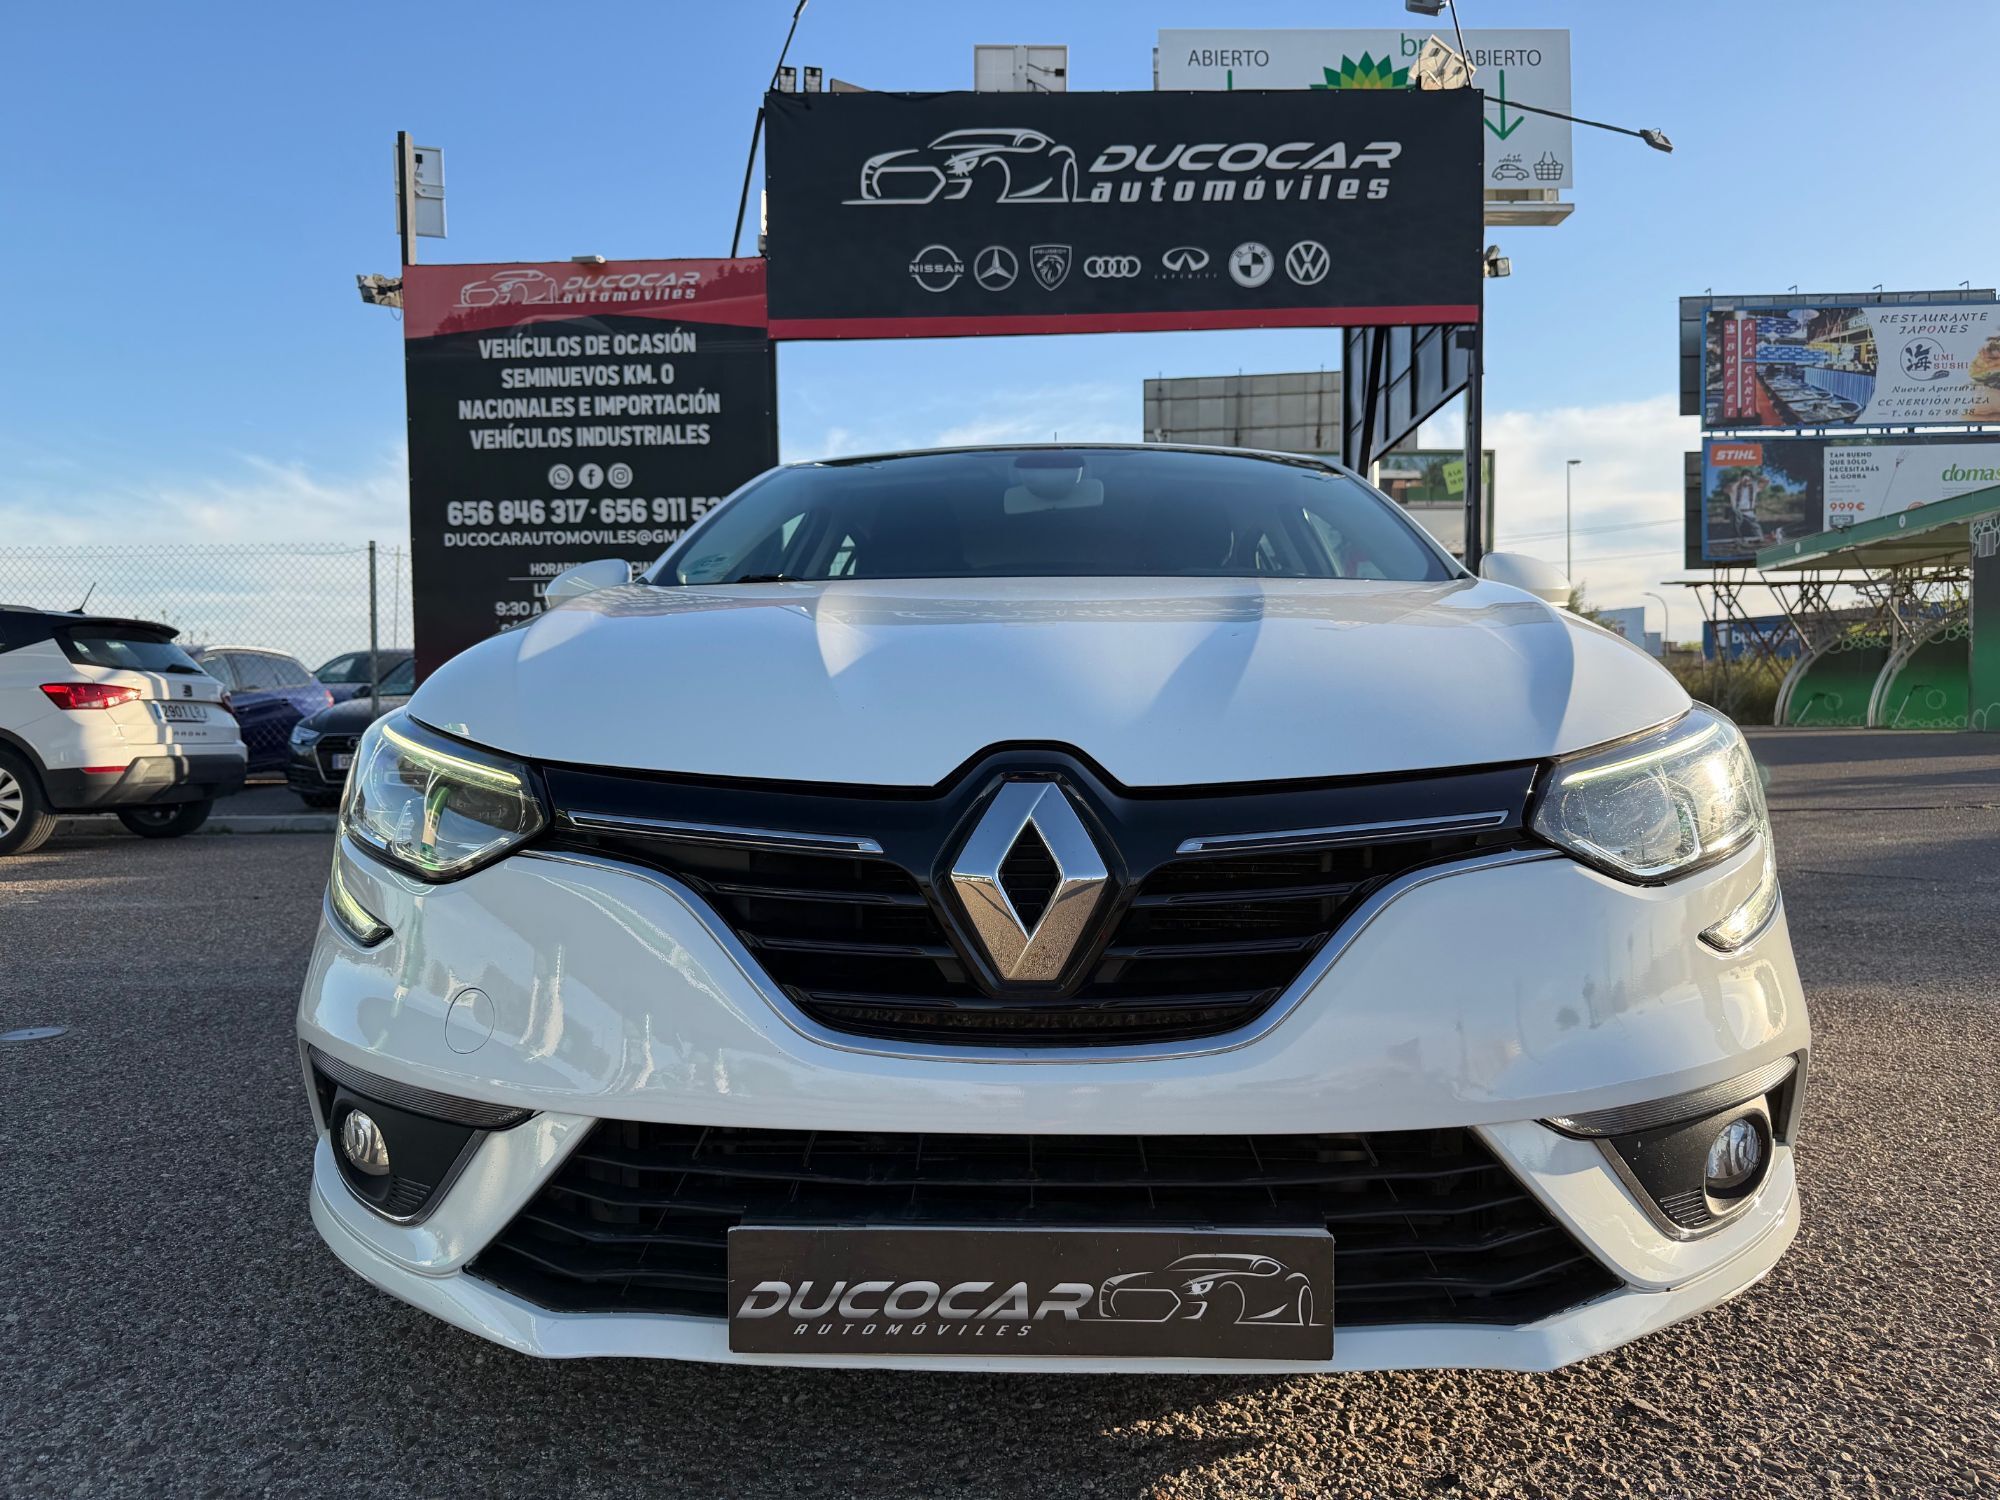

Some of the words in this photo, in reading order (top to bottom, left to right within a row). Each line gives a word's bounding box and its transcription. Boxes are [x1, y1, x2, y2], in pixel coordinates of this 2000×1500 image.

[1188, 49, 1269, 67] ABIERTO
[1466, 49, 1542, 67] ABIERTO
[1088, 142, 1402, 172] DUCOCAR
[1089, 175, 1390, 203] automóviles
[908, 264, 965, 273] NISSAN
[562, 272, 701, 290] DUCOCAR
[1879, 312, 1989, 324] RESTAURANTE
[1898, 324, 1969, 335] JAPONES
[478, 333, 582, 360] VEHÍCULOS
[584, 335, 611, 357] DE
[613, 327, 697, 356] OCASIÓN
[1905, 343, 1933, 372] 海
[1933, 353, 1955, 361] UMI
[1933, 361, 1970, 370] SUSHI
[501, 365, 621, 389] SEMINUEVOS
[623, 364, 657, 385] KM.
[1891, 385, 1926, 394] Nueva
[1928, 385, 1977, 394] Apertura
[458, 399, 576, 421] NACIONALES
[579, 398, 592, 417] E
[594, 388, 721, 417] IMPORTACIÓN
[1877, 399, 1894, 407] CC
[1953, 396, 1990, 405] PLAZA
[470, 423, 573, 450] VEHÍCULOS
[576, 424, 711, 447] INDUSTRIALES
[1715, 449, 1757, 460] STIHL
[447, 500, 495, 526] 656
[498, 499, 546, 525] 846
[652, 497, 688, 522] 911
[1830, 502, 1865, 512] 999€
[495, 600, 530, 616] 9:30
[736, 1280, 1096, 1321] DUCOCAR
[793, 1322, 1033, 1336] AUTOMÓVILES
